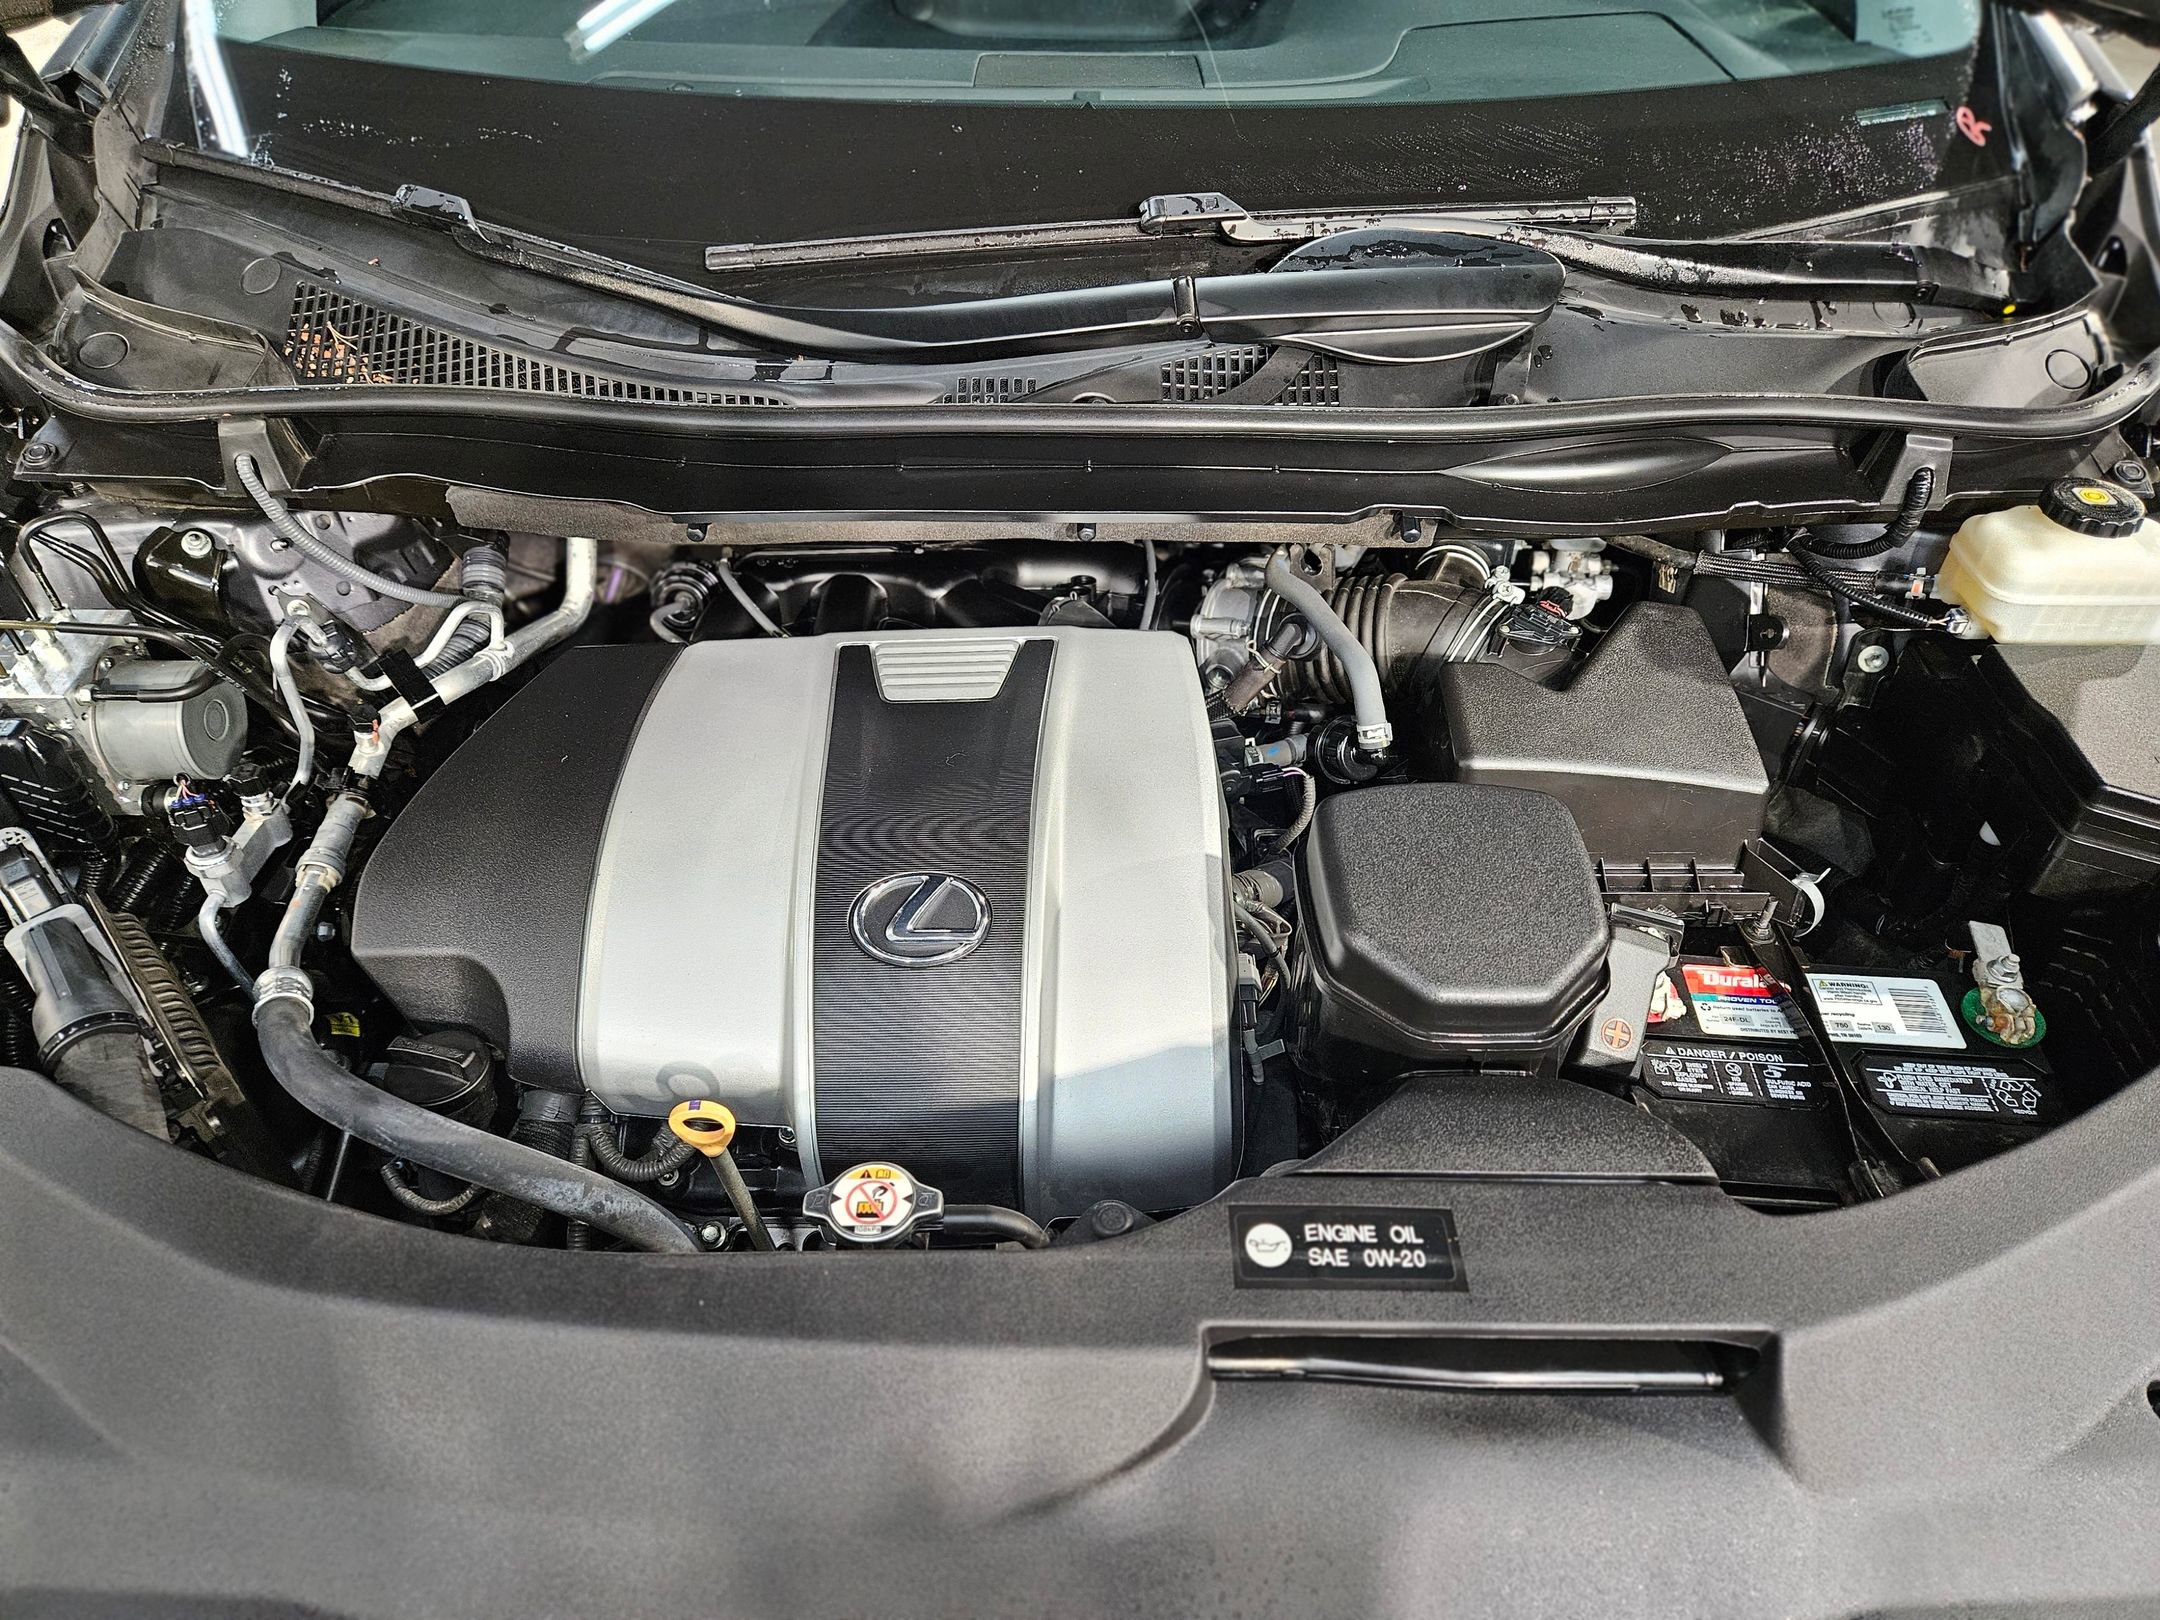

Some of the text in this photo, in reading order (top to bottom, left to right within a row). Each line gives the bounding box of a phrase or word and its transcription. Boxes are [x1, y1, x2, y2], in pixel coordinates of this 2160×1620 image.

[1697, 970, 1792, 992] Dural
[1677, 1047, 1727, 1060] DANGER
[1739, 1052, 1784, 1063] POISON
[1765, 1079, 1796, 1087] SULFURIC
[1303, 1223, 1424, 1244] ENGINE OIL
[1308, 1248, 1427, 1269] SAE 0W-20
